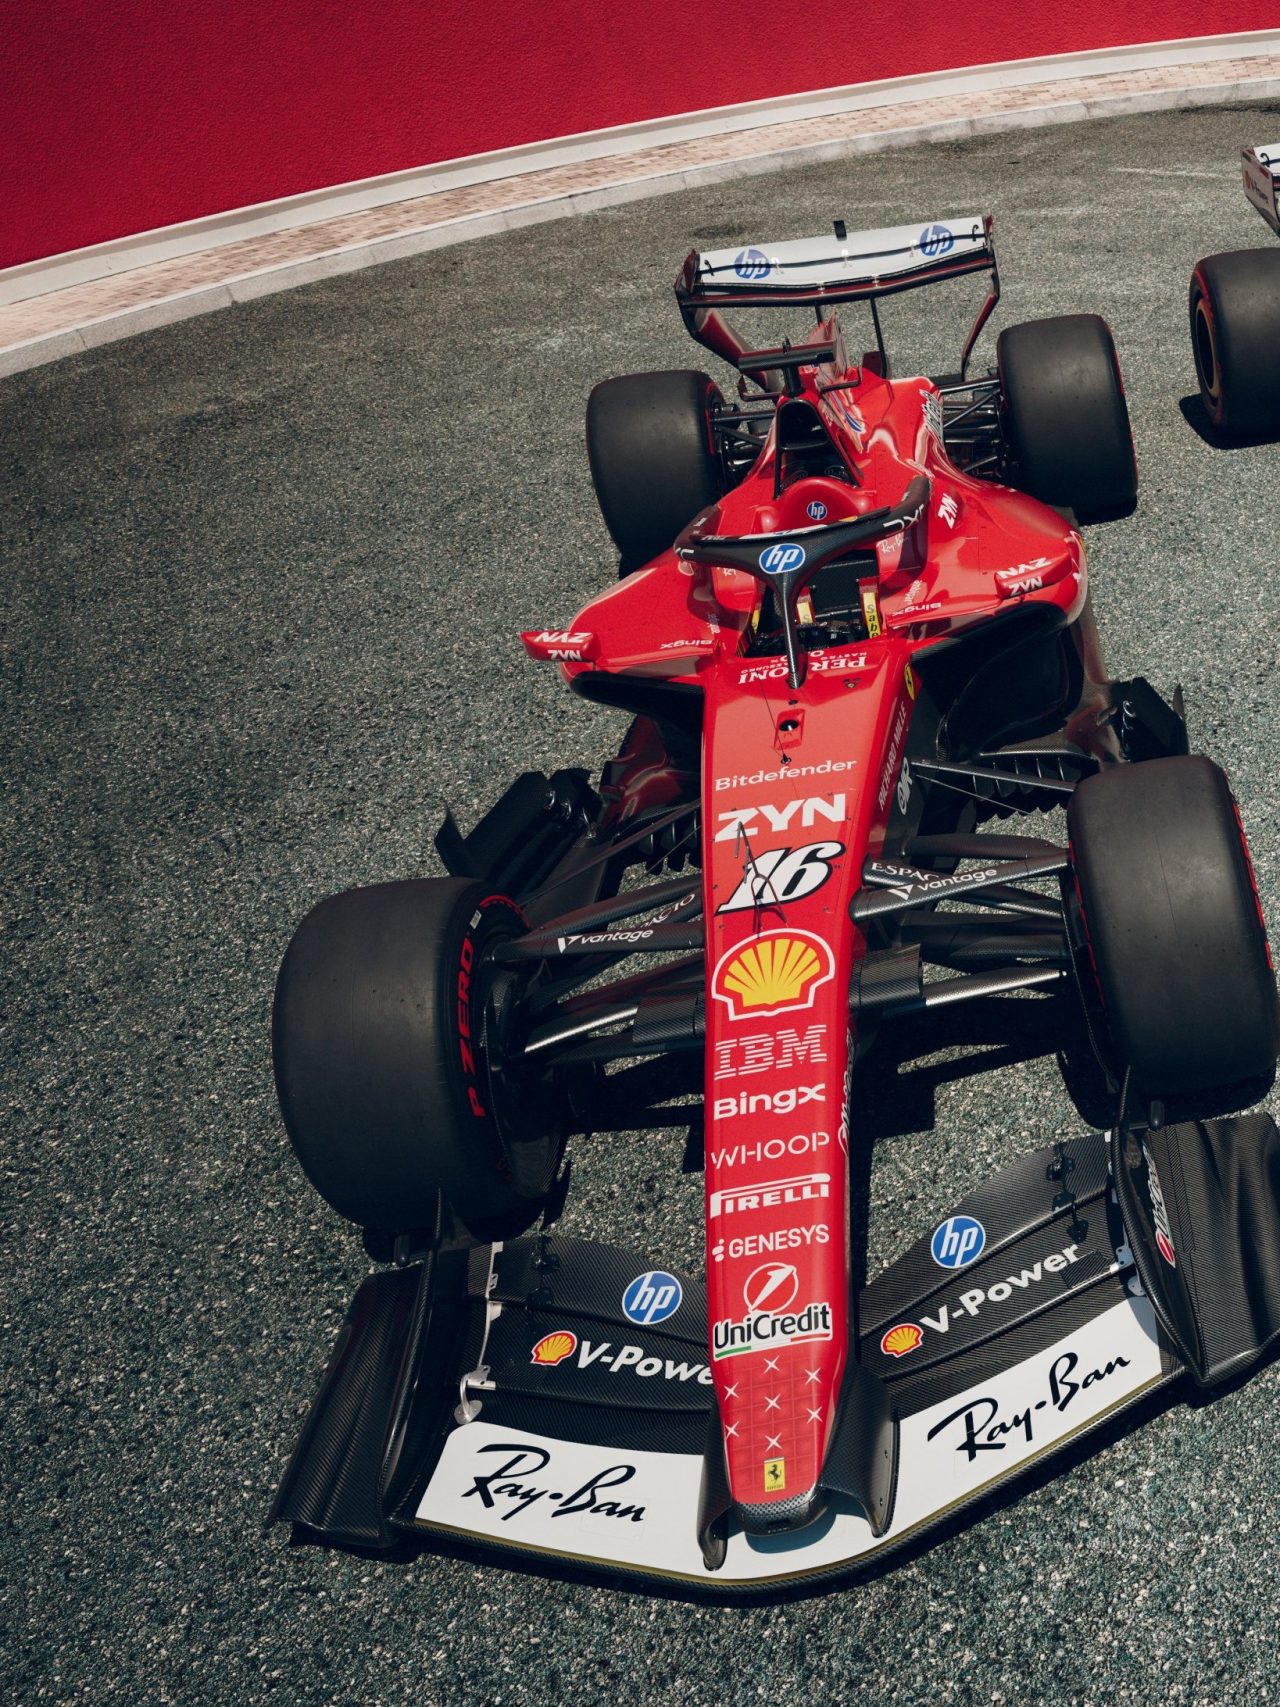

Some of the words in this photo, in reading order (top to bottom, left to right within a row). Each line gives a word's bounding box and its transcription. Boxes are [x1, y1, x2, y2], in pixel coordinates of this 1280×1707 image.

[923, 225, 951, 256] hp
[738, 250, 768, 279] hp
[809, 501, 826, 520] hp
[762, 543, 804, 573] hp
[715, 760, 858, 791] Bitdefender
[714, 793, 847, 843] ZYN
[713, 840, 847, 917] 16
[917, 868, 998, 891] vantage
[581, 929, 654, 945] vantage
[457, 936, 477, 1077] ZERO
[713, 1024, 828, 1081] IBM
[467, 1086, 486, 1117] P
[711, 1131, 830, 1170] WHOOP
[709, 1173, 831, 1219] PIRELLI
[728, 1223, 830, 1259] GENESYS
[937, 1215, 981, 1268] hp
[626, 1271, 679, 1324] hp
[919, 1244, 1080, 1334] V-Power
[713, 1304, 831, 1349] UniCredit
[577, 1340, 714, 1386] V-Powe
